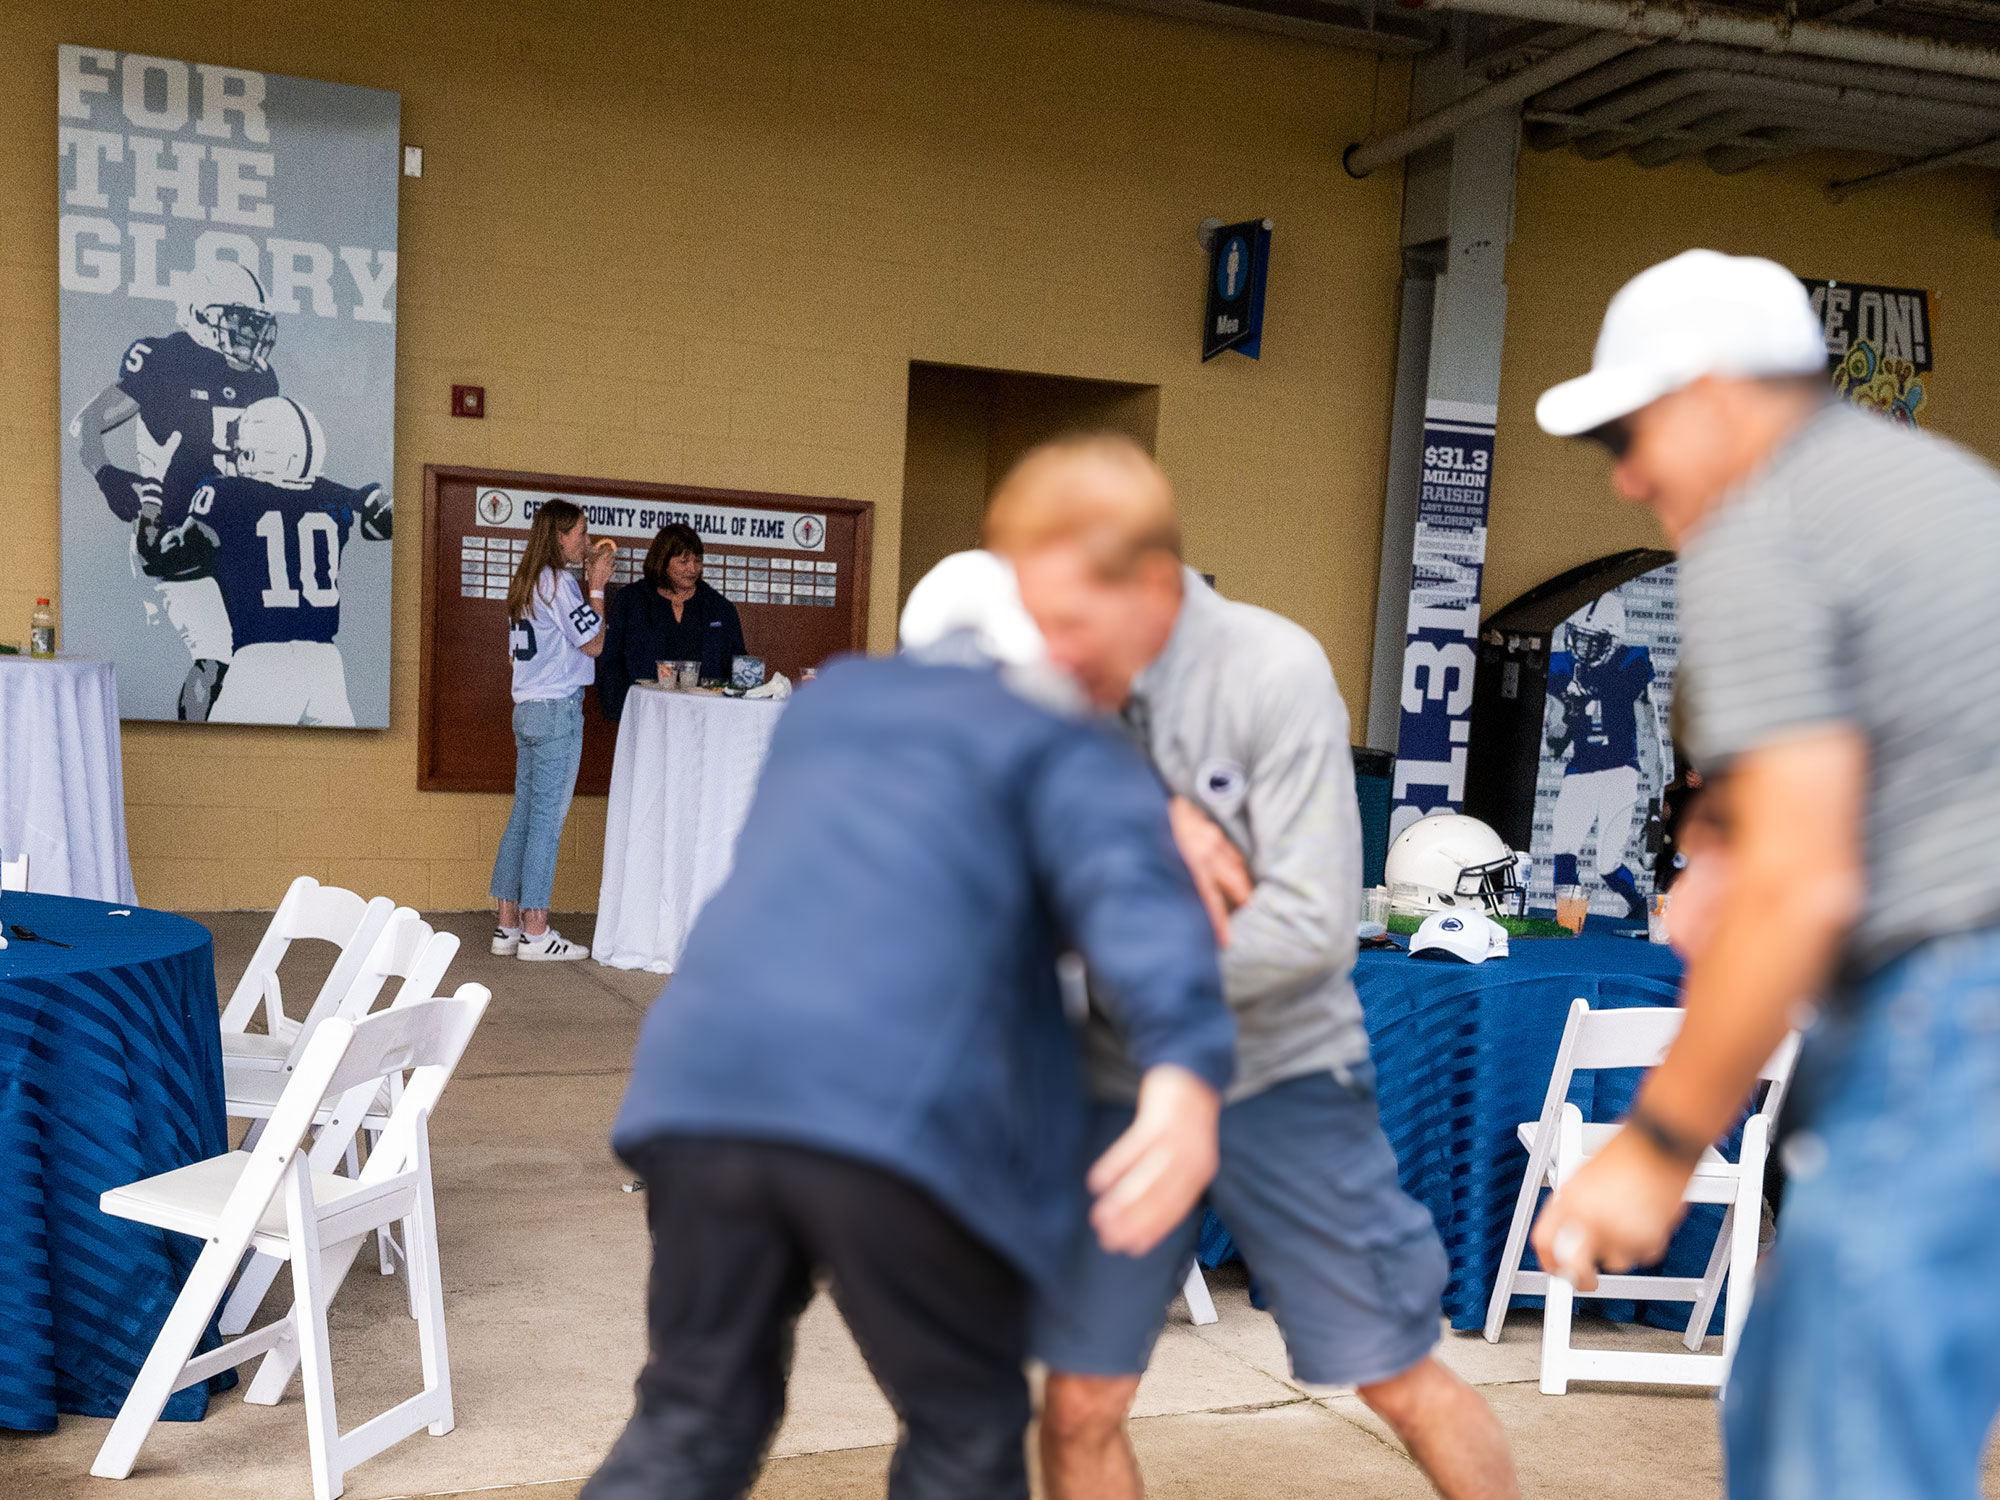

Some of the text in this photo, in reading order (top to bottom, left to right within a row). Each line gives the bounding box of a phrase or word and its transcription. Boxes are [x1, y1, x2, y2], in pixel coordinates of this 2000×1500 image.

[59, 46, 270, 143] FOR
[59, 126, 274, 228] THE
[59, 215, 397, 324] GLORY
[1858, 291, 1926, 364] ON!
[125, 342, 152, 374] 5
[1424, 445, 1488, 472] $31.3
[1423, 469, 1487, 488] MILLION
[1421, 485, 1485, 505] RAISED
[640, 509, 690, 529] SPORTS
[694, 514, 727, 534] HALL
[731, 516, 747, 536] OF
[750, 518, 785, 539] FAME
[256, 511, 340, 607] 10
[569, 603, 600, 635] 25
